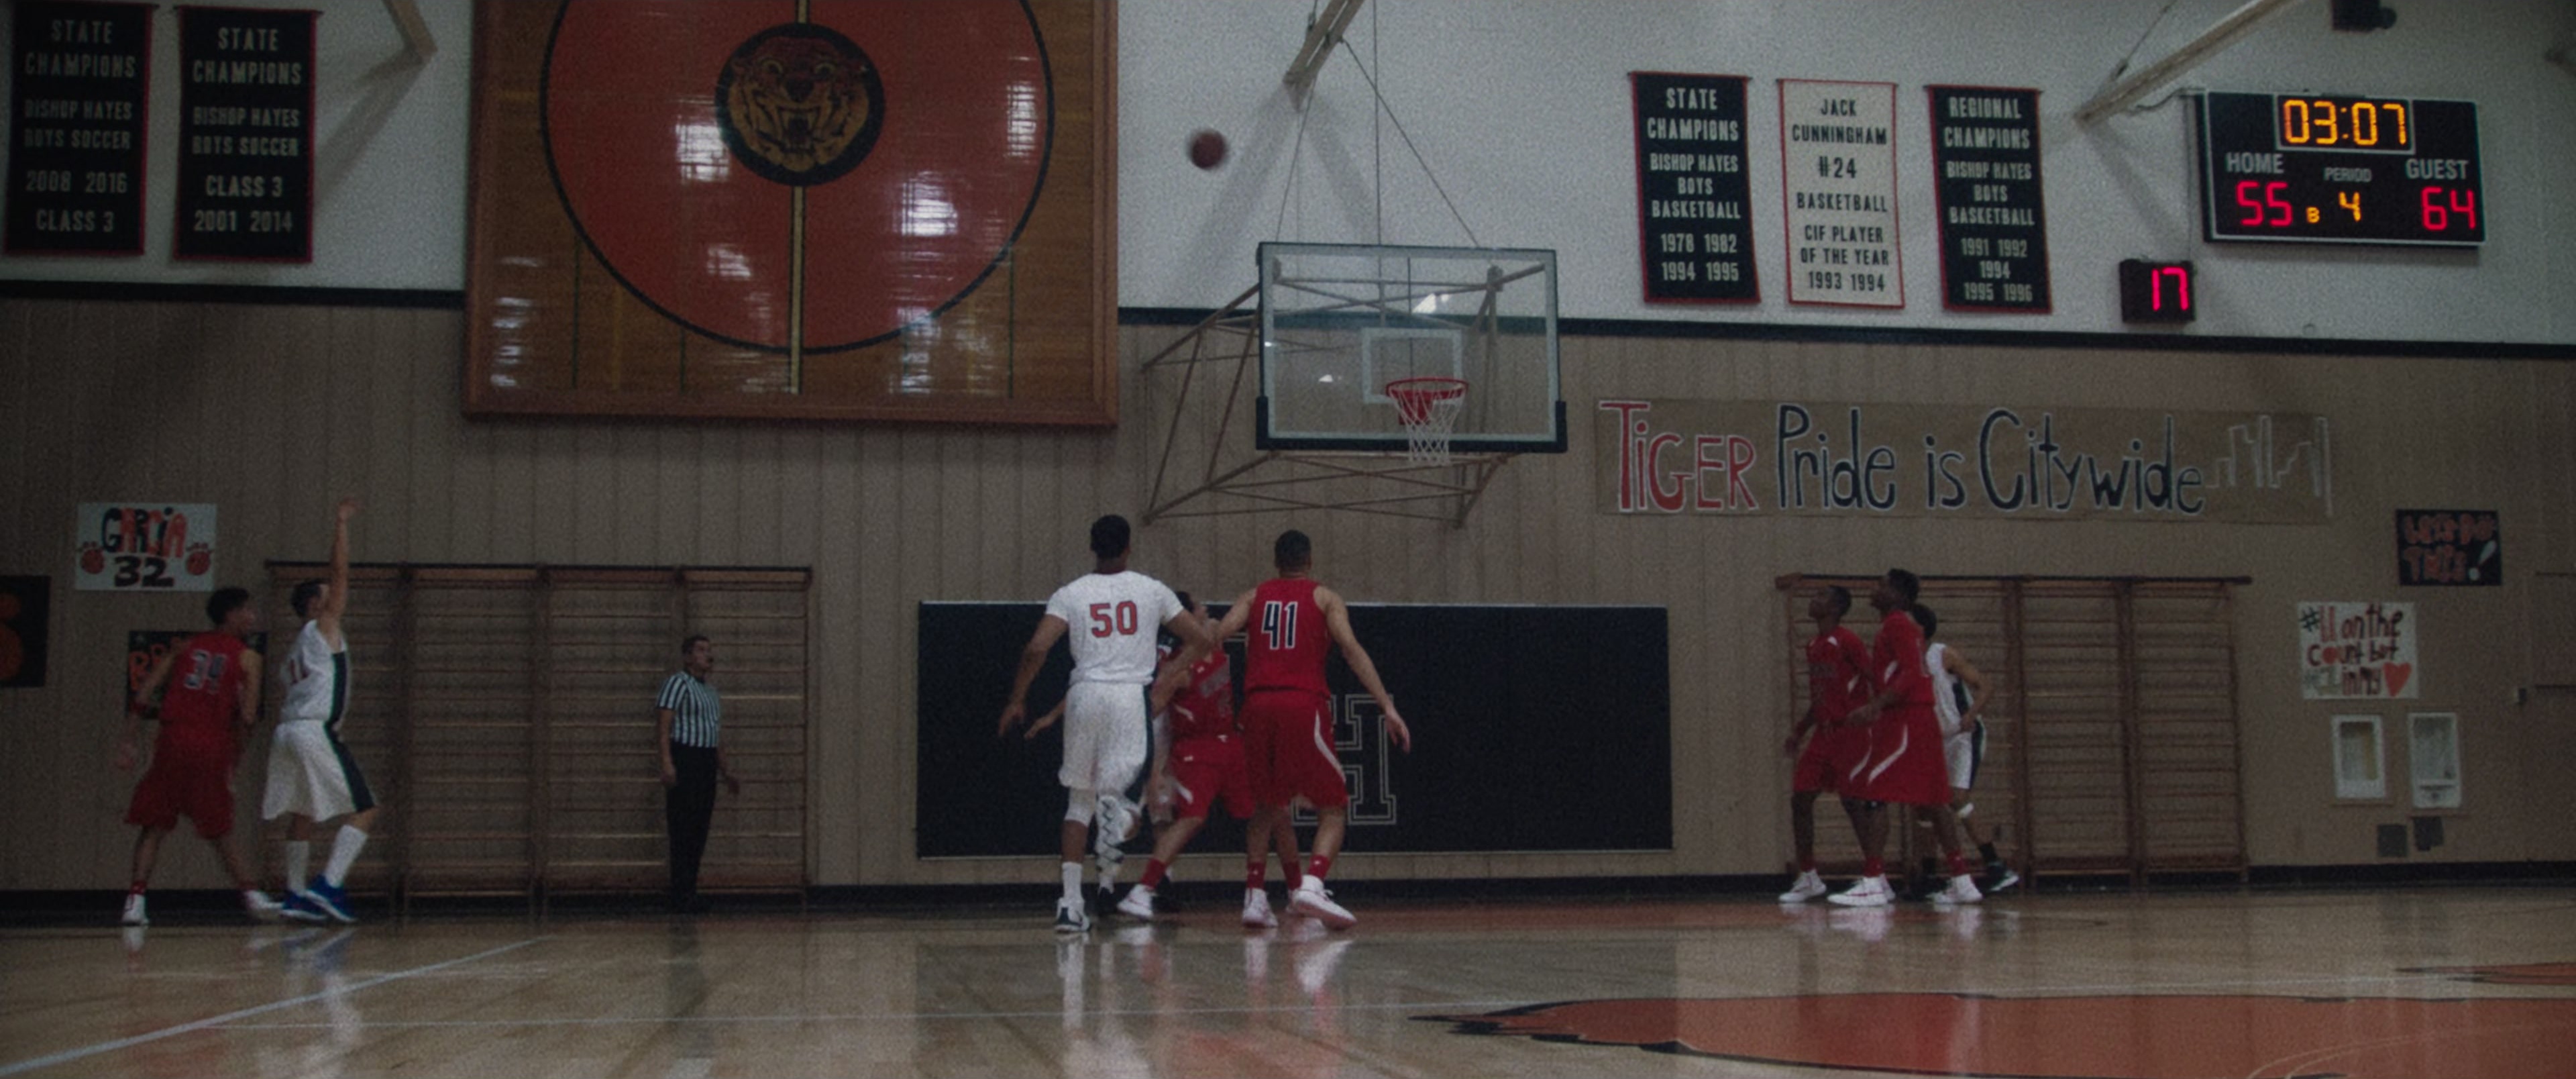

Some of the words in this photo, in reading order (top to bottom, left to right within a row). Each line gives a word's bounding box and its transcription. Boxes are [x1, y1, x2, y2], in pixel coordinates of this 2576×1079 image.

[52, 20, 112, 44] STATE
[218, 28, 278, 51] STATE
[25, 53, 135, 78] CHAMPIONS
[193, 60, 301, 85] CHAMPIONS
[1666, 88, 1717, 109] STATE
[1821, 99, 1856, 115] JACK
[1949, 97, 2022, 119] REGIONAL
[25, 99, 77, 119] BISHOP
[83, 101, 131, 121] HAYES
[193, 107, 246, 125] BISHOP
[251, 108, 299, 127] HAYES
[1647, 118, 1739, 141] CHAMPIONS
[2283, 99, 2406, 146] 03:07
[24, 129, 64, 148] BOYS
[71, 131, 130, 150] SOCCER
[1792, 124, 1886, 144] CUNNINGHAM
[1944, 127, 2030, 149] CHAMPIONS
[192, 137, 233, 154] BOYS
[239, 138, 299, 156] SOCCER
[1650, 153, 1694, 171] BISHOP
[1699, 155, 1737, 172] HAYES
[1819, 156, 1856, 178] #24
[1947, 160, 1990, 178] BISHOP
[1993, 162, 2032, 180] HAYES
[2226, 152, 2284, 174] HOME
[2406, 159, 2468, 181] GUEST
[1678, 177, 1713, 194] BOYS
[2324, 167, 2372, 183] PERIOD
[206, 175, 265, 197] CLASS
[272, 177, 282, 197] 3
[1974, 184, 2007, 201] BOYS
[1652, 200, 1741, 219] BASKETBALL
[1797, 193, 1887, 211] BASKETBALL
[2236, 181, 2292, 227] 55
[2339, 191, 2361, 221] 4
[2421, 187, 2475, 231] 64
[36, 209, 95, 232] CLASS
[103, 212, 114, 232] 3
[195, 211, 237, 231] 2001
[250, 211, 292, 232] 2014
[1949, 206, 2035, 225] BASKETBALL
[1705, 234, 1737, 252] 1982
[1805, 225, 1824, 240] CIF
[1832, 226, 1882, 243] PLAYER
[1801, 248, 1815, 263] OF
[1823, 248, 1847, 264] THE
[1854, 250, 1888, 266] YEAR
[1961, 238, 1989, 256] 1991
[1997, 240, 2027, 258] 1992
[1662, 262, 1696, 280] 1994
[1707, 262, 1738, 280] 1995
[1979, 260, 2011, 279] 1994
[1809, 271, 1842, 289] 1993
[1851, 274, 1885, 291] 1994
[1964, 282, 1994, 300] 1995
[2151, 266, 2189, 311] 17
[1778, 404, 1896, 511] Pride
[1925, 434, 1967, 509] is
[1978, 408, 2205, 514] Citywide
[114, 556, 174, 587] 32
[1089, 601, 1138, 637] 50
[1261, 601, 1298, 650] 41
